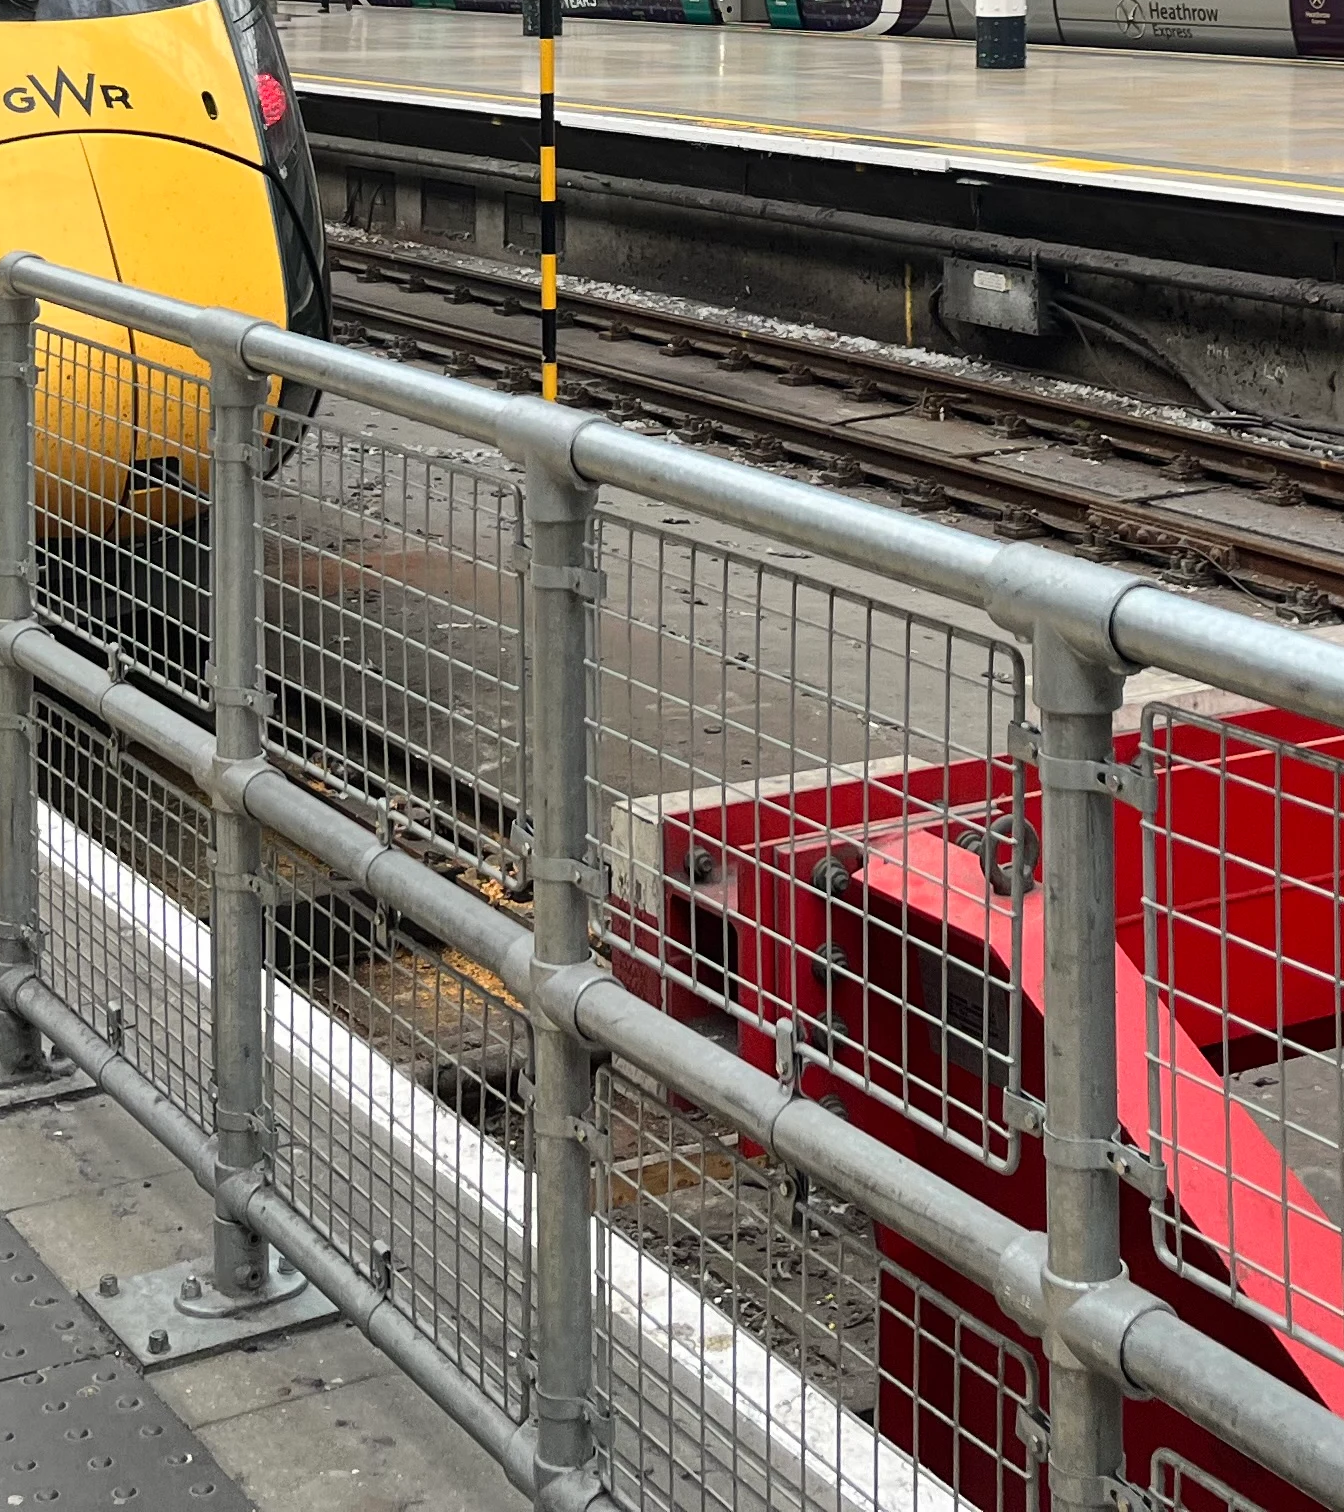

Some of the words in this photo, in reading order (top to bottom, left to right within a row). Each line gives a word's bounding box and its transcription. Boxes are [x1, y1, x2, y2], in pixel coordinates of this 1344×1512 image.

[1149, 1, 1218, 21] Heathrow
[1152, 24, 1193, 39] Express
[3, 65, 134, 118] GWR
